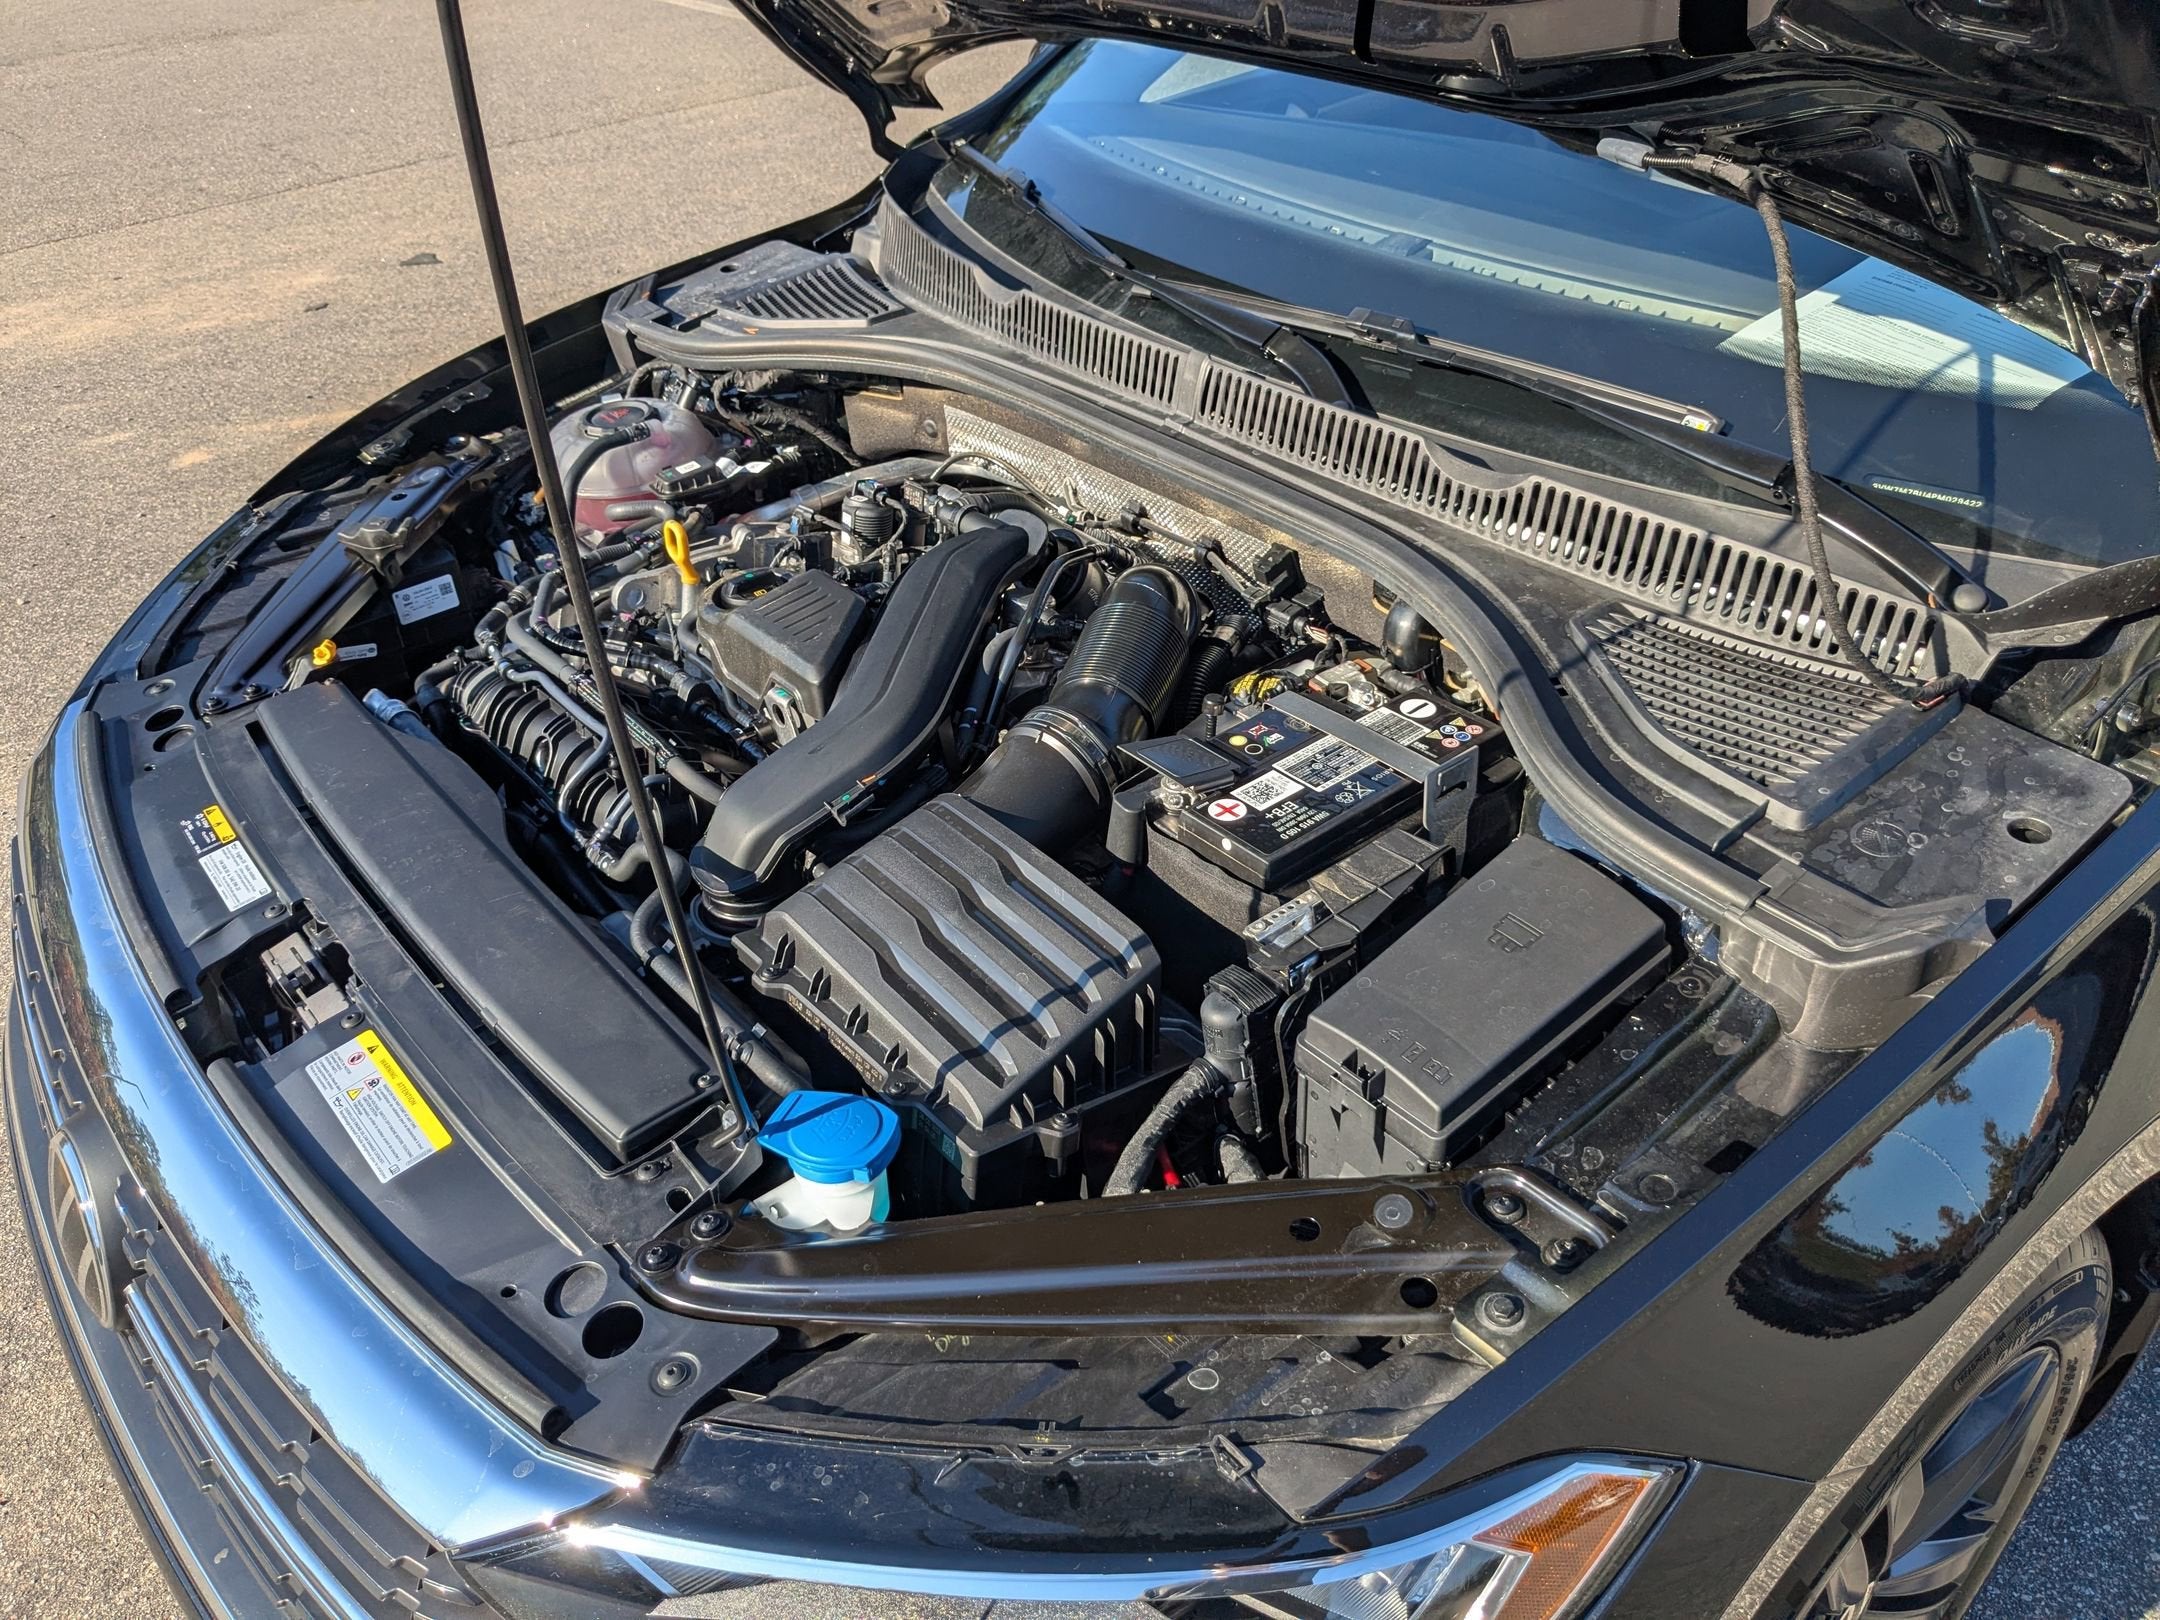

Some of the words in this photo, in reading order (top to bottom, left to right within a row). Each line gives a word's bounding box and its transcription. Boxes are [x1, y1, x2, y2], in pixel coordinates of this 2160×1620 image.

[1265, 801, 1299, 819] EFB+
[1299, 818, 1315, 829] 915
[1285, 826, 1301, 837] 105
[380, 1058, 398, 1080] WARNING
[396, 1081, 417, 1106] ATTENTION
